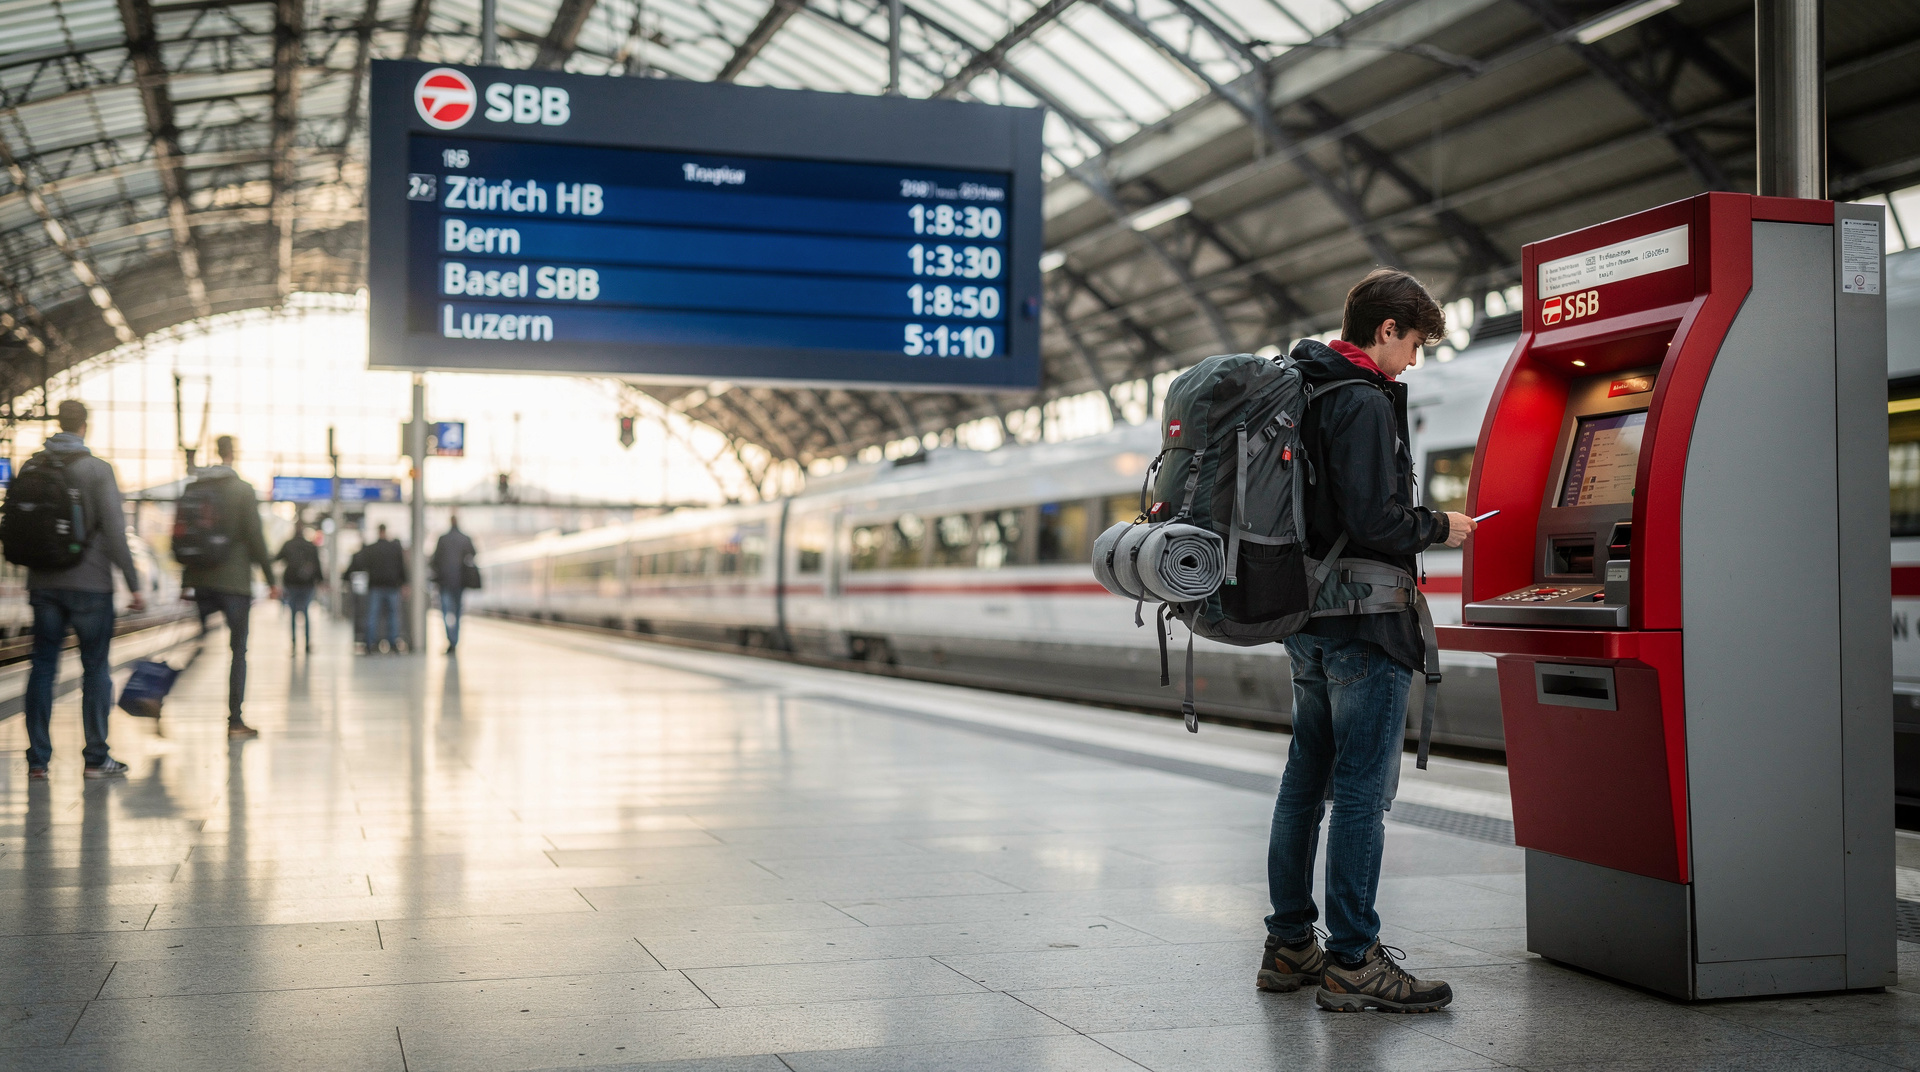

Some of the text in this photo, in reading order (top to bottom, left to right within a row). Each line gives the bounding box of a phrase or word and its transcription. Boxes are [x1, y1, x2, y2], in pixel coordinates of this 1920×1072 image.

[484, 82, 571, 126] SBB
[444, 175, 548, 213] Zürich
[556, 182, 604, 216] HB
[444, 218, 521, 255] Bern
[908, 204, 1002, 239] 1:8:30
[907, 243, 1002, 279] 1:3:30
[444, 262, 600, 301] Basel SBB
[907, 283, 1001, 319] 1:8:50
[443, 303, 554, 342] Luzern
[902, 323, 995, 359] 5:1:10
